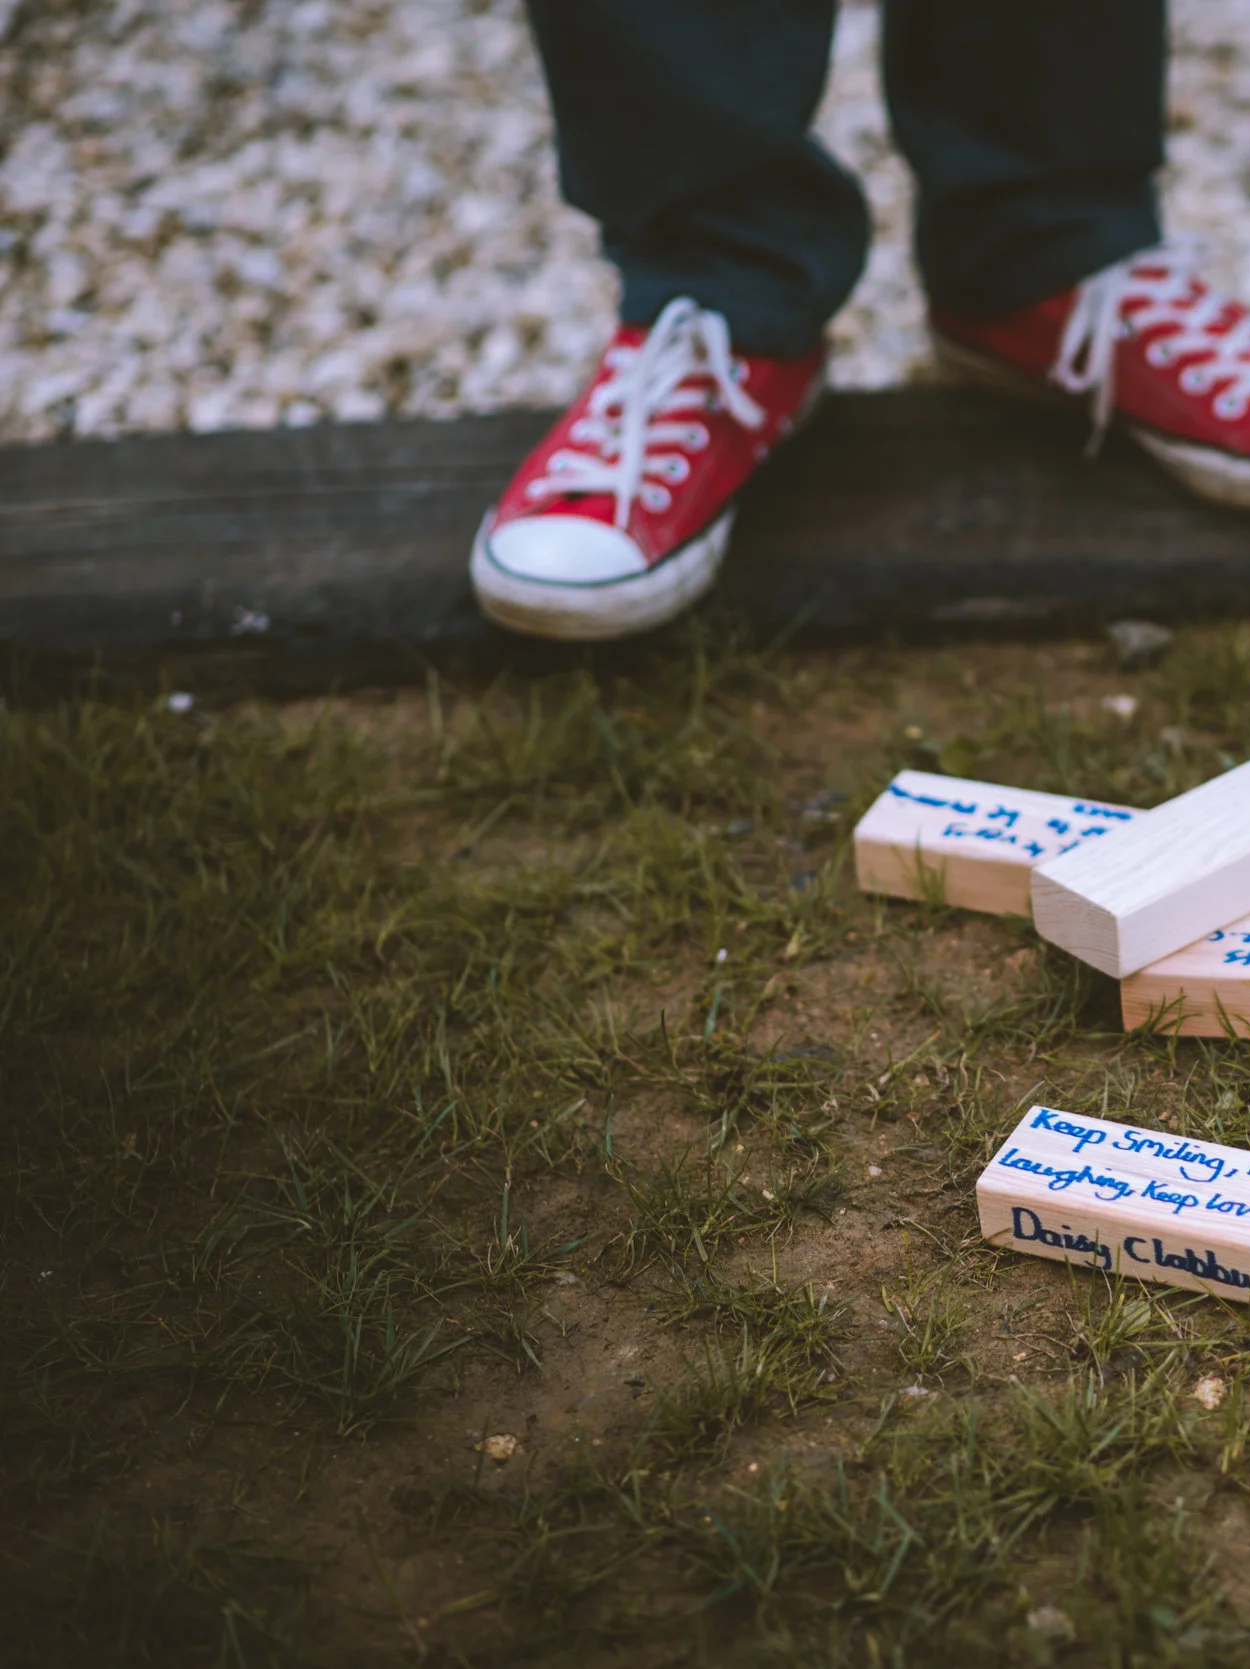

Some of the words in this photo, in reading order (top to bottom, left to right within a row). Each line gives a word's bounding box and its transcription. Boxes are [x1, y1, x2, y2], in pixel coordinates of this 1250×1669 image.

[1030, 1109, 1107, 1152] Keep
[1112, 1130, 1238, 1182] Smiling,
[1141, 1180, 1199, 1214] Keep
[1011, 1206, 1112, 1270] Daisy
